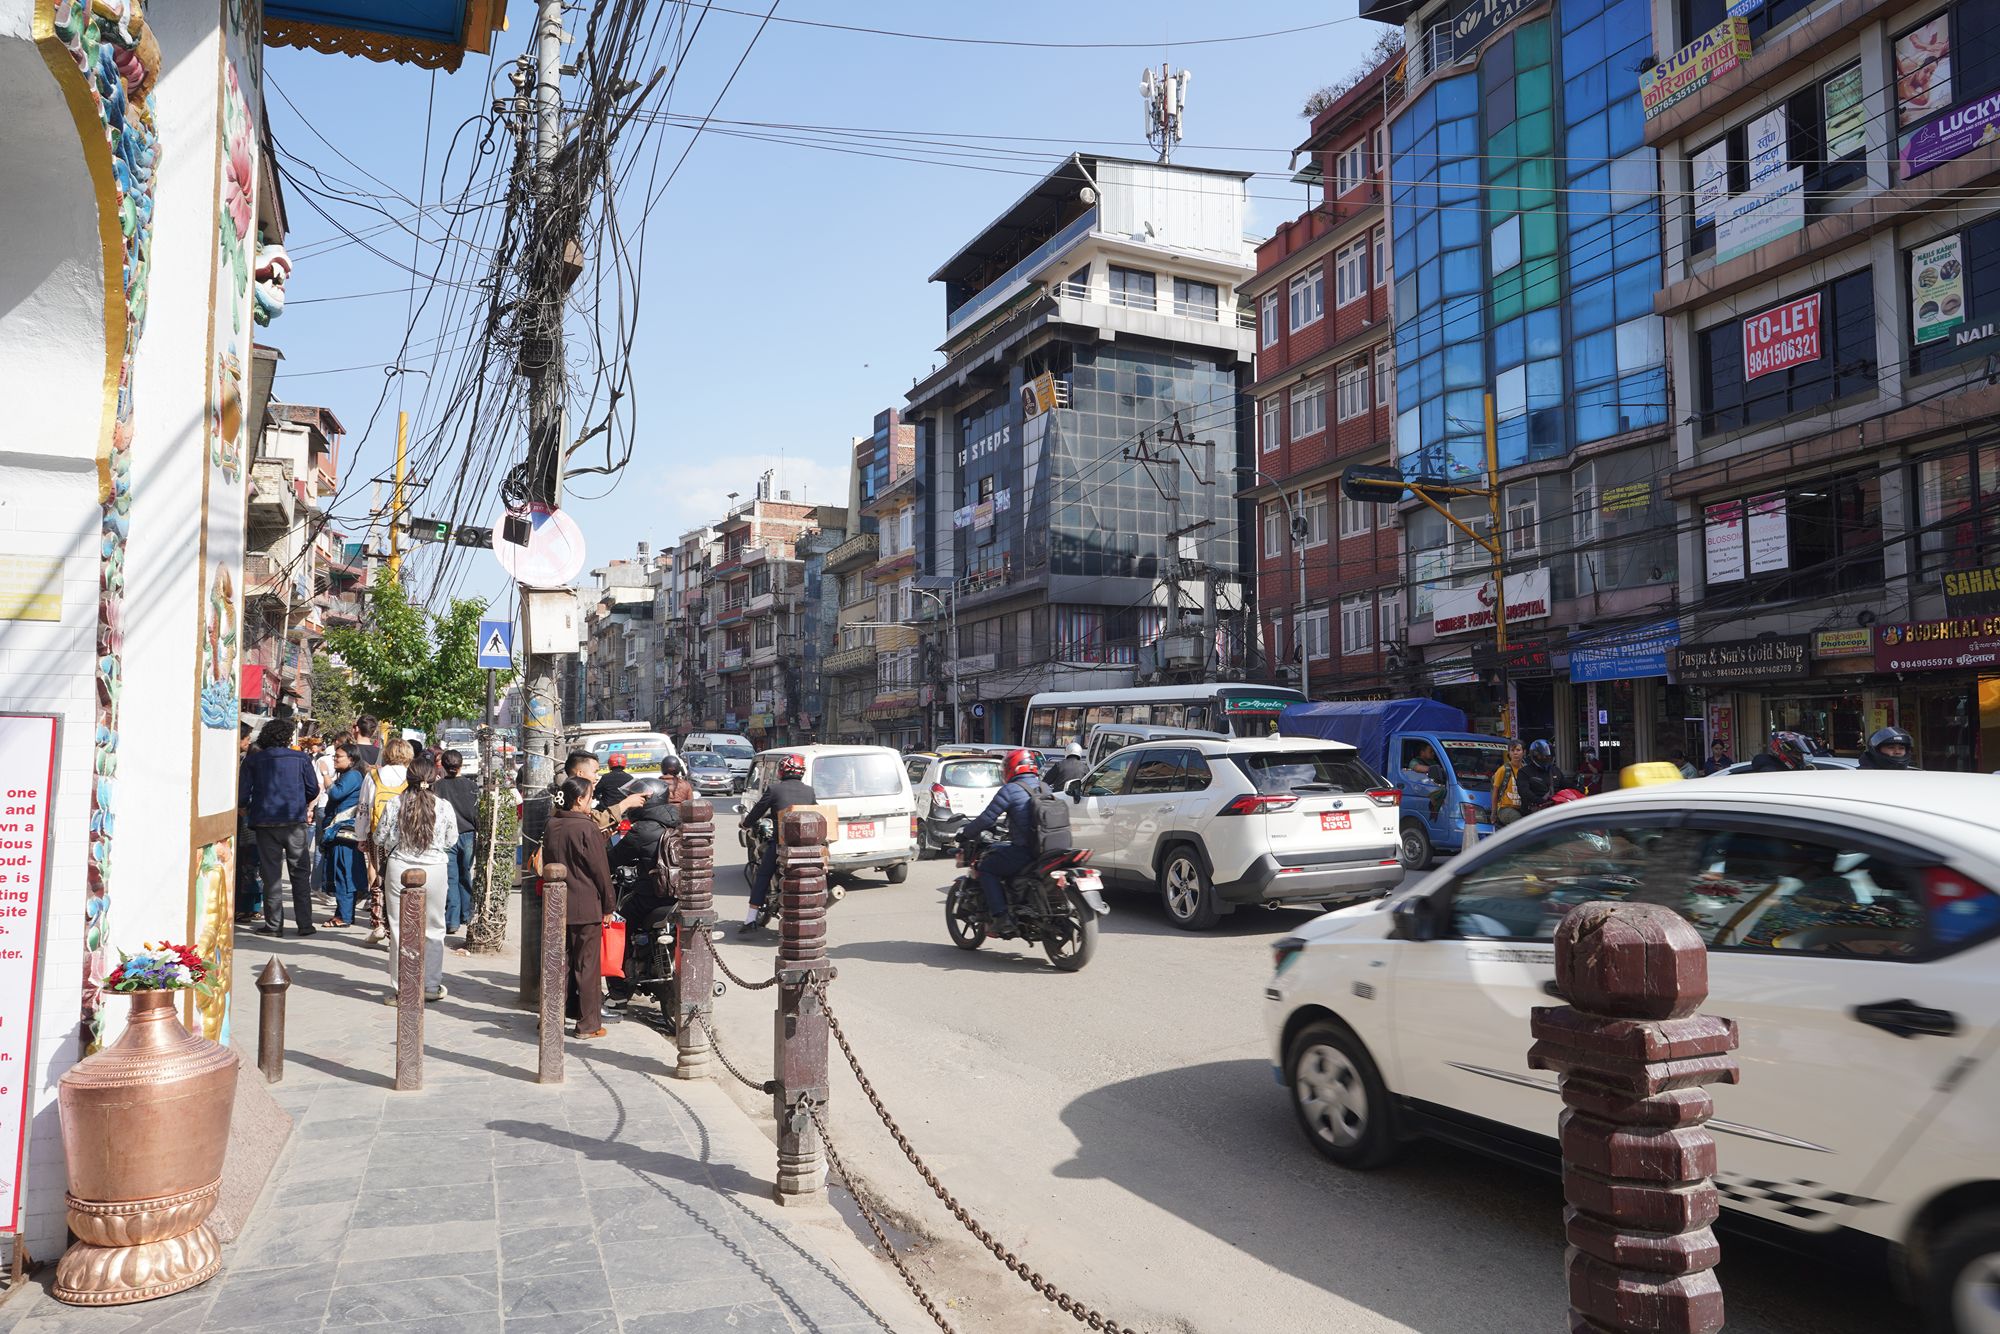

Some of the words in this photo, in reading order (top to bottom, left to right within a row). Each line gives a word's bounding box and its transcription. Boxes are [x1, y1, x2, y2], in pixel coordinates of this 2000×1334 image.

[1656, 34, 1714, 80] STUPA
[1644, 64, 1697, 109] कोरियन
[1701, 40, 1735, 72] भाषा
[1653, 75, 1708, 115] 9765-351316
[1938, 94, 2000, 137] LUCKY
[1732, 194, 1762, 217] STUPA
[1763, 180, 1799, 205] DENTAL
[1917, 249, 1935, 262] NAILS
[1746, 300, 1817, 348] TO-LET
[1749, 332, 1818, 374] 9841506321
[958, 449, 968, 468] 13
[971, 425, 1011, 461] STEPS
[1435, 614, 1467, 634] CHINESE
[1505, 598, 1546, 619] HOSPITAL
[1821, 639, 1867, 648] Photocopy
[1905, 619, 1981, 643] BUDDHILAL
[1621, 638, 1679, 657] PHARMACY
[1678, 650, 1707, 670] Puspa
[1709, 647, 1718, 666] &
[1719, 645, 1746, 665] Son's
[1747, 642, 1773, 662] Gold
[1775, 640, 1803, 663] Shop
[1900, 658, 1953, 669] 9849055976
[1238, 699, 1282, 709] Apple
[7, 789, 37, 798] one
[5, 804, 36, 815] and
[24, 823, 34, 832] a
[16, 872, 30, 883] is
